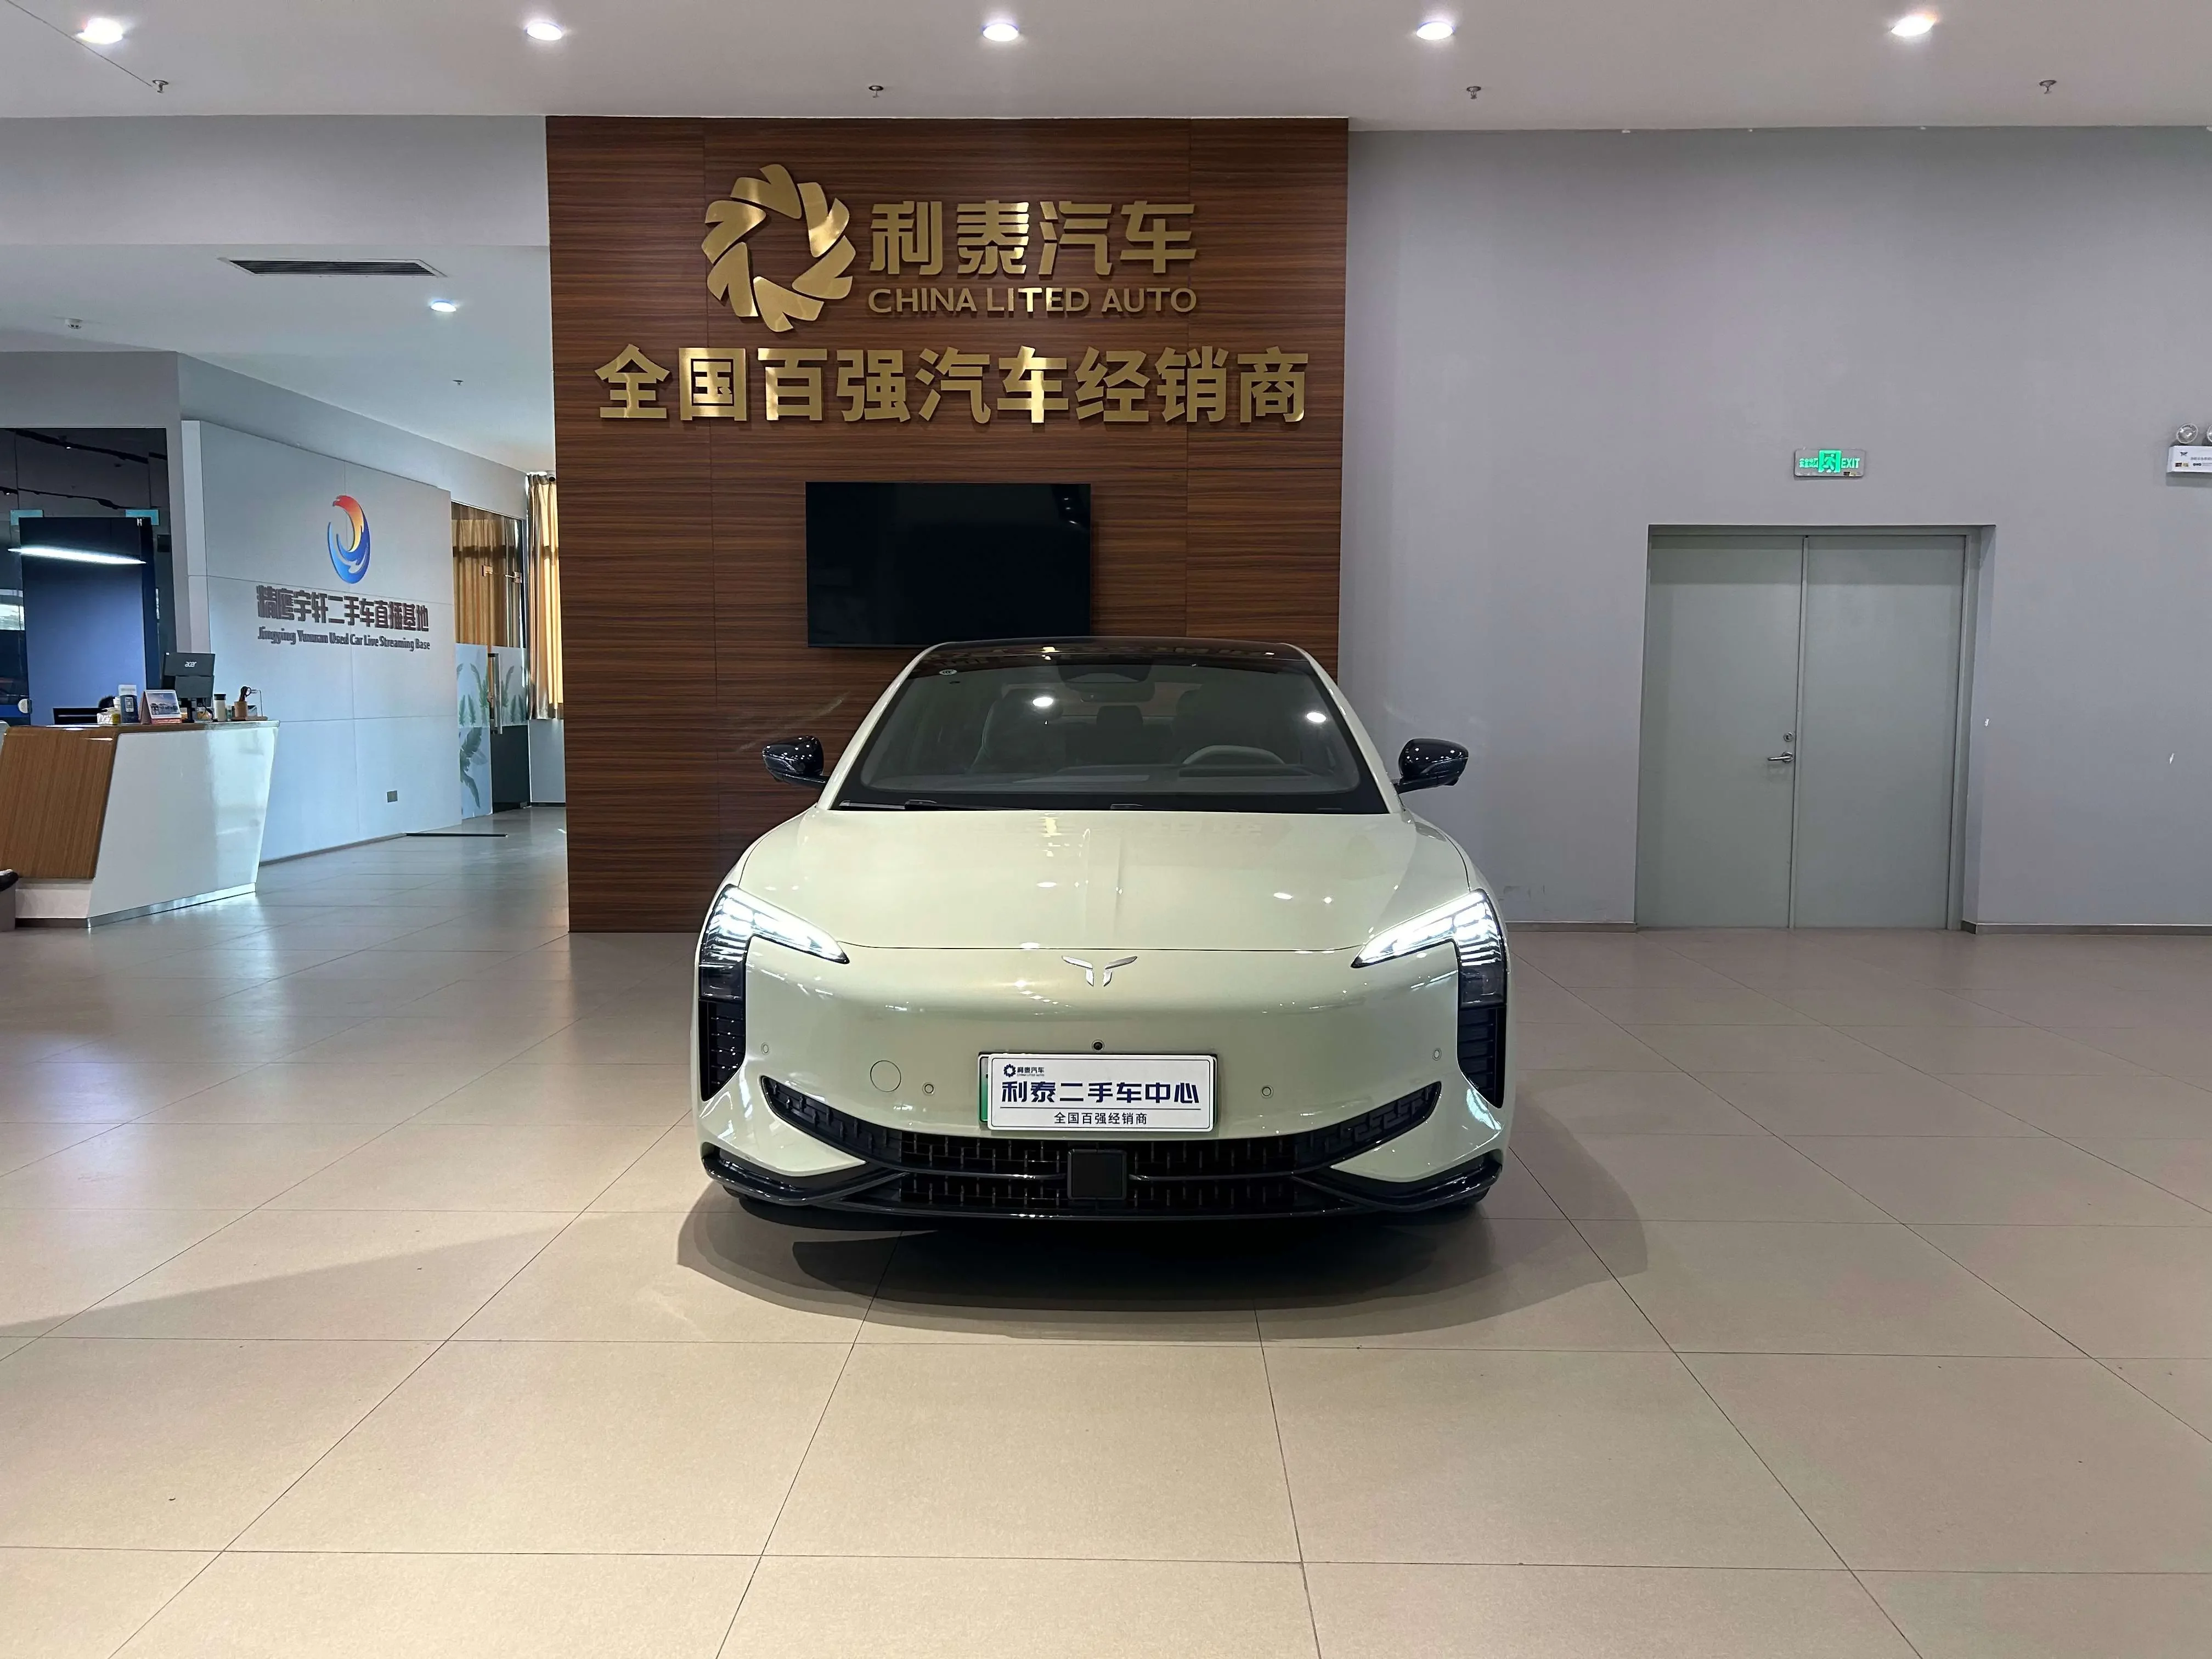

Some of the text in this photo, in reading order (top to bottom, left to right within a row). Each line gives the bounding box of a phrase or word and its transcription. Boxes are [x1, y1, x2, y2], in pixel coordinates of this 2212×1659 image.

[869, 200, 1197, 275] 利泰汽车
[867, 287, 1197, 313] CHINA LITED AUTO
[595, 343, 1309, 425] 全国百强汽车经销商
[1841, 458, 1860, 469] EXIT
[329, 632, 349, 645] Used
[350, 634, 363, 646] Car
[364, 635, 379, 647] Live
[379, 636, 414, 652] Streaming
[415, 638, 430, 650] Base
[1002, 1081, 1200, 1104] 利泰二手车中心
[1054, 1111, 1148, 1125] 全国百强经销商
